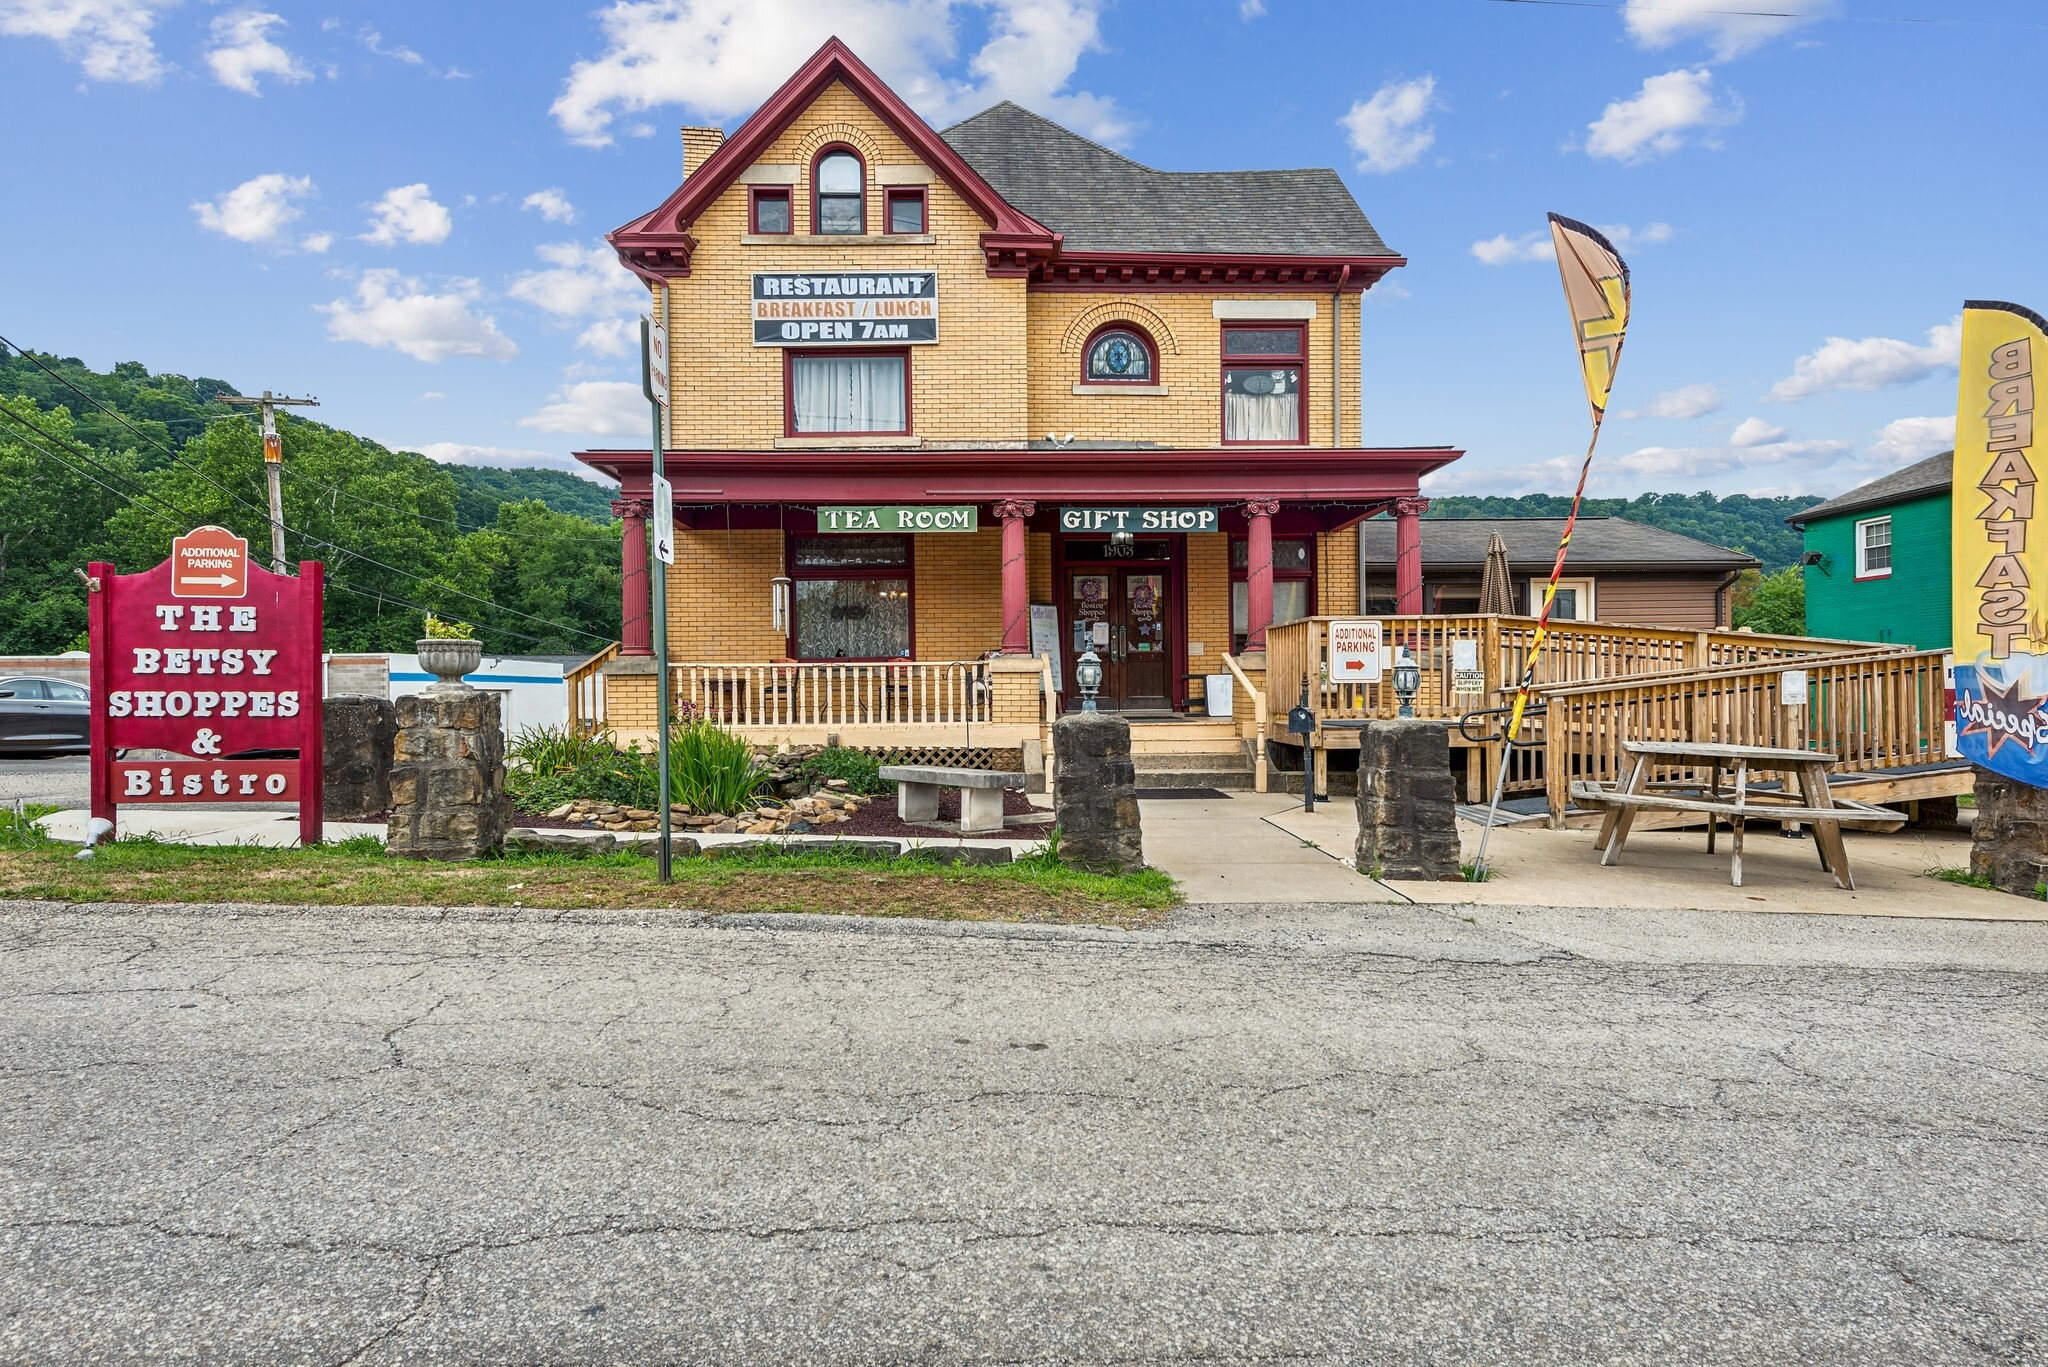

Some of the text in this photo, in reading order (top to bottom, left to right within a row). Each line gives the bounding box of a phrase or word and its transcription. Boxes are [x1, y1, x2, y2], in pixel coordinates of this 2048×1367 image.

[763, 277, 925, 296] RESTAURANT
[757, 301, 856, 318] BREAKFAST
[875, 300, 932, 317] LUNCH
[781, 322, 909, 340] OPEN 7AM
[653, 335, 662, 359] NO
[824, 510, 971, 530] TEA ROOM
[1062, 510, 1216, 530] GIFT SHOP
[180, 547, 240, 559] ADDITIONAL
[1103, 544, 1134, 557] 1903
[187, 558, 233, 570] PARKING
[156, 605, 258, 632] THE
[1335, 628, 1377, 640] ADDITIONAL
[1336, 641, 1375, 653] PARKING
[133, 648, 278, 675] BETSY
[109, 690, 300, 718] SHOPPES
[191, 728, 222, 755] &
[123, 768, 288, 797] Bistro
